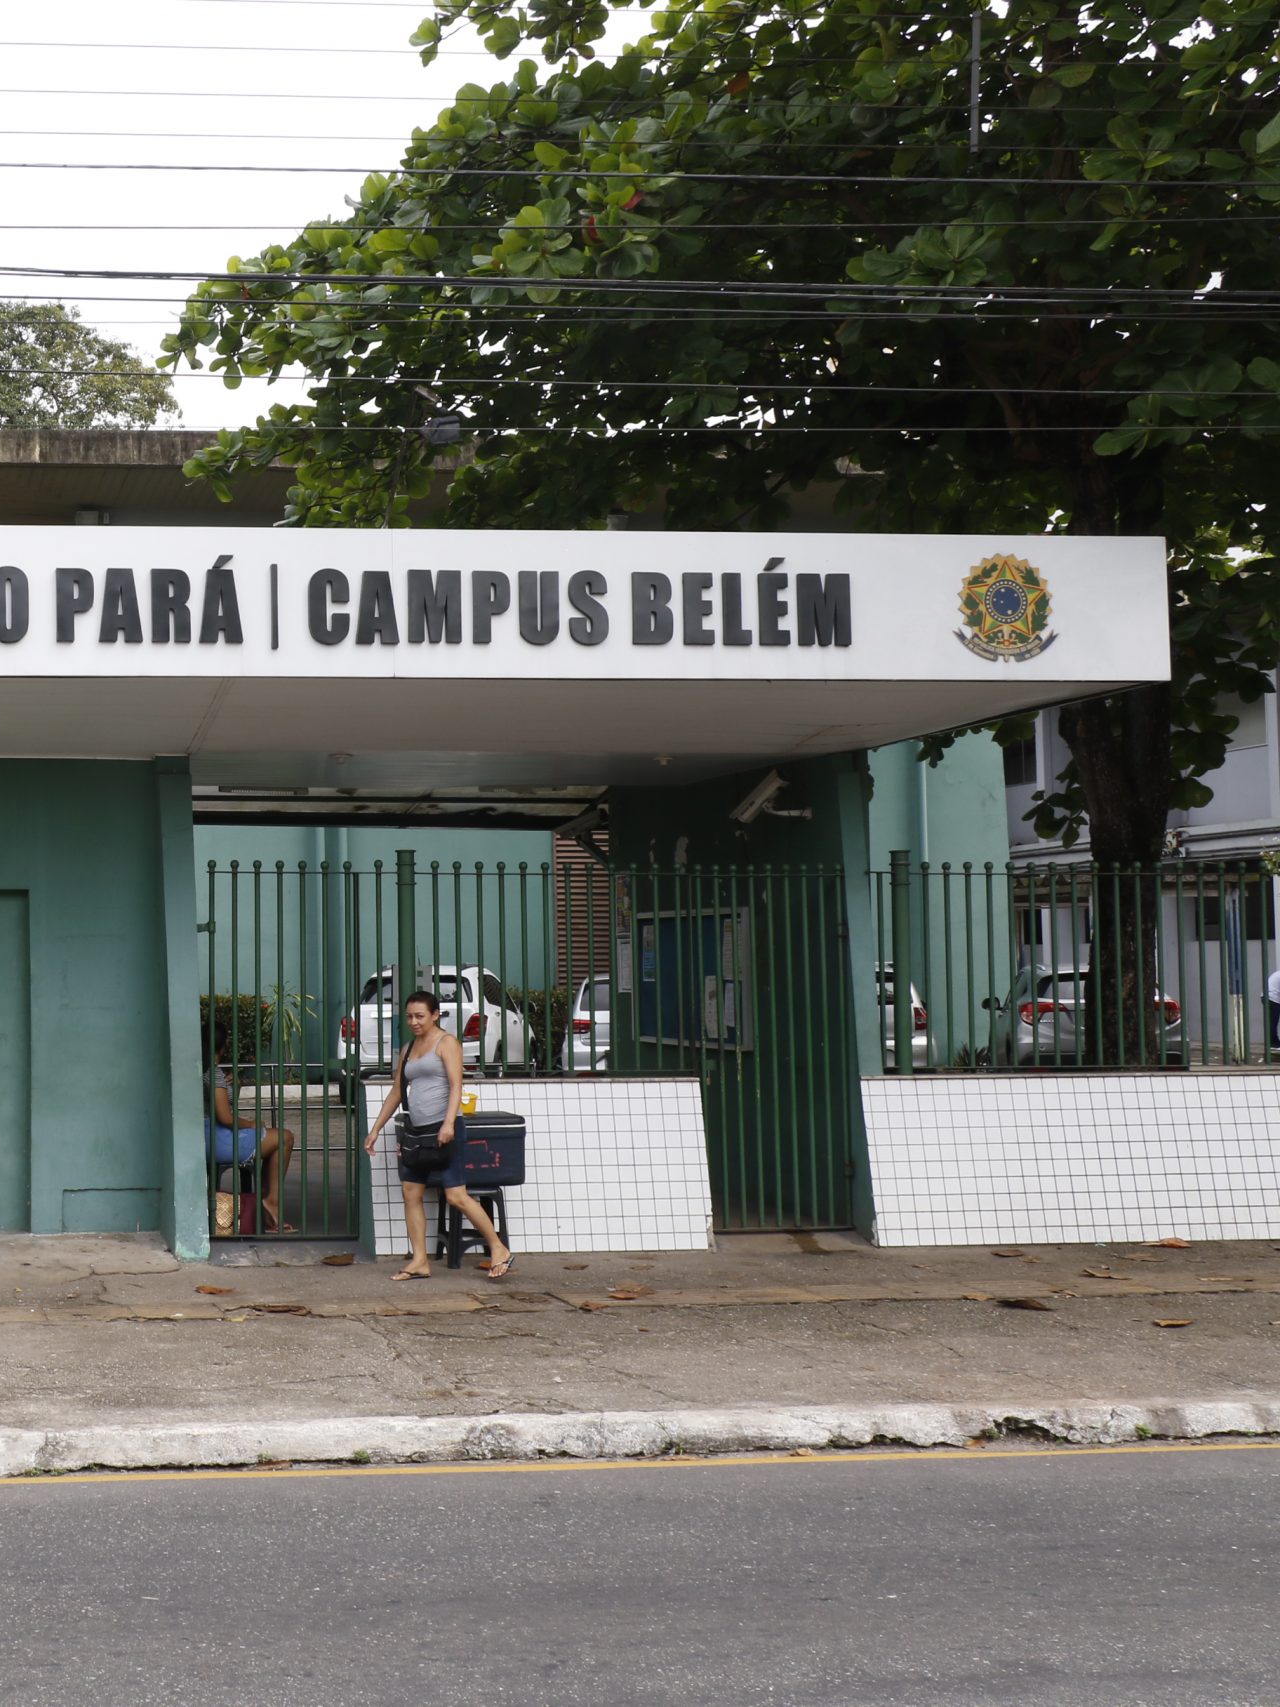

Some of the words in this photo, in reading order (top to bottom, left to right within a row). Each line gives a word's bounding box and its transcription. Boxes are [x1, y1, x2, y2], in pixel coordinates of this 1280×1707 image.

[56, 554, 244, 646] PARÁ
[307, 568, 609, 647] CAMPUS
[631, 557, 852, 648] BELÉM
